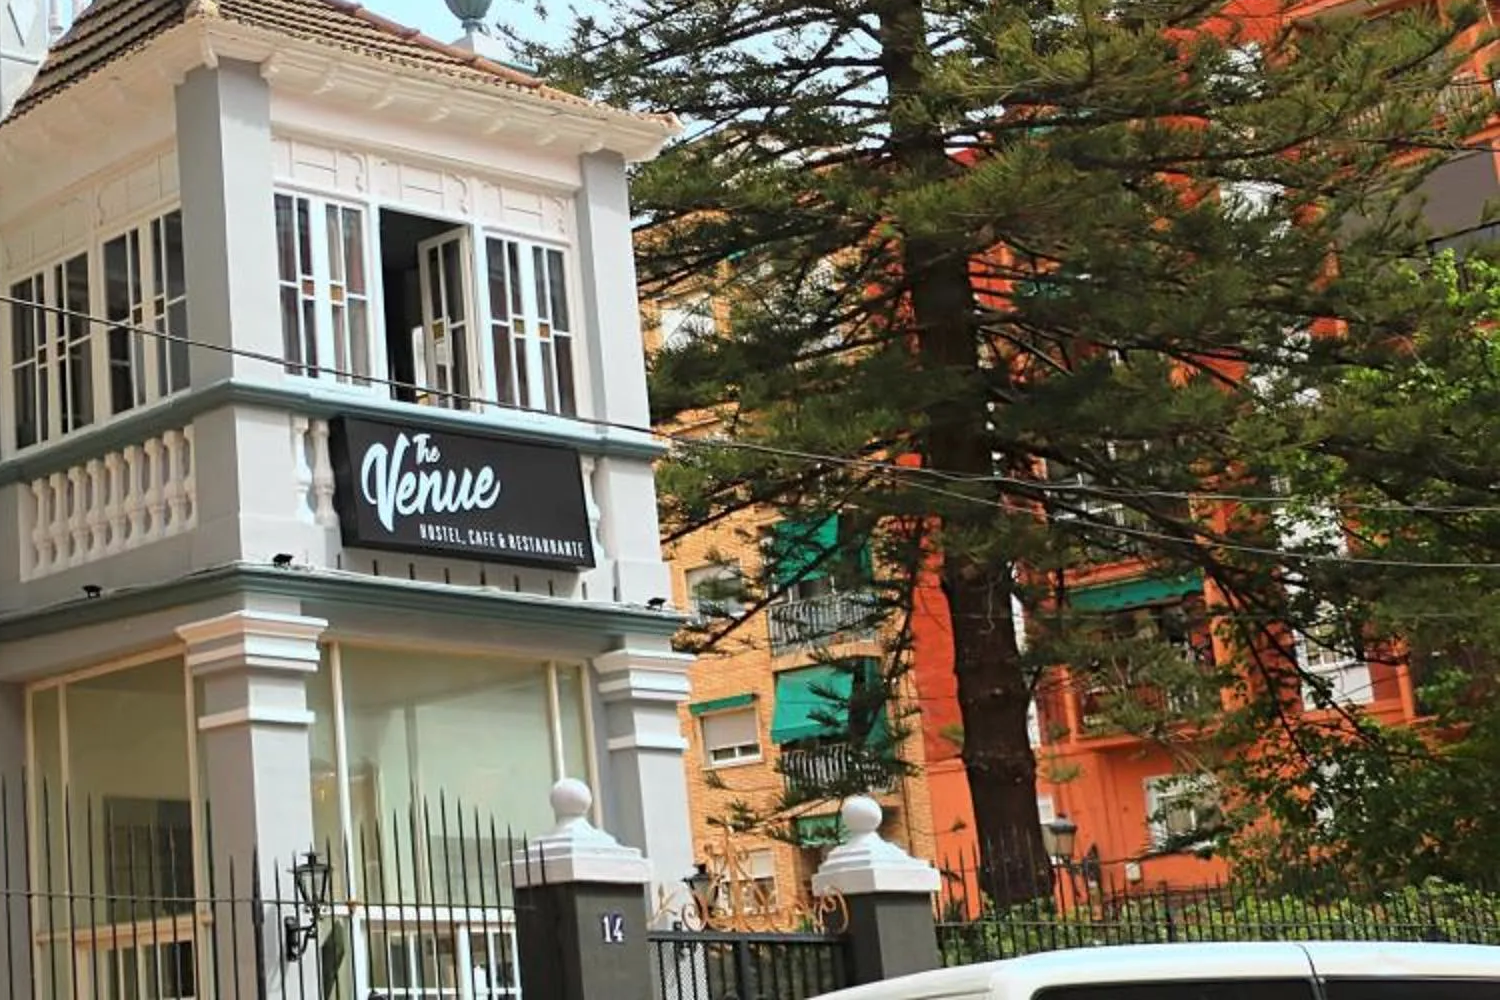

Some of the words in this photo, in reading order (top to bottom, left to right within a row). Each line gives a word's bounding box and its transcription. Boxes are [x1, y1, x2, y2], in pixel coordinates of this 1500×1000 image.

[412, 432, 441, 463] The
[360, 431, 501, 532] Venue
[419, 523, 466, 545] HOSTEL,
[498, 532, 507, 549] &
[507, 533, 585, 559] RESTAURANTE
[602, 914, 624, 943] 14
